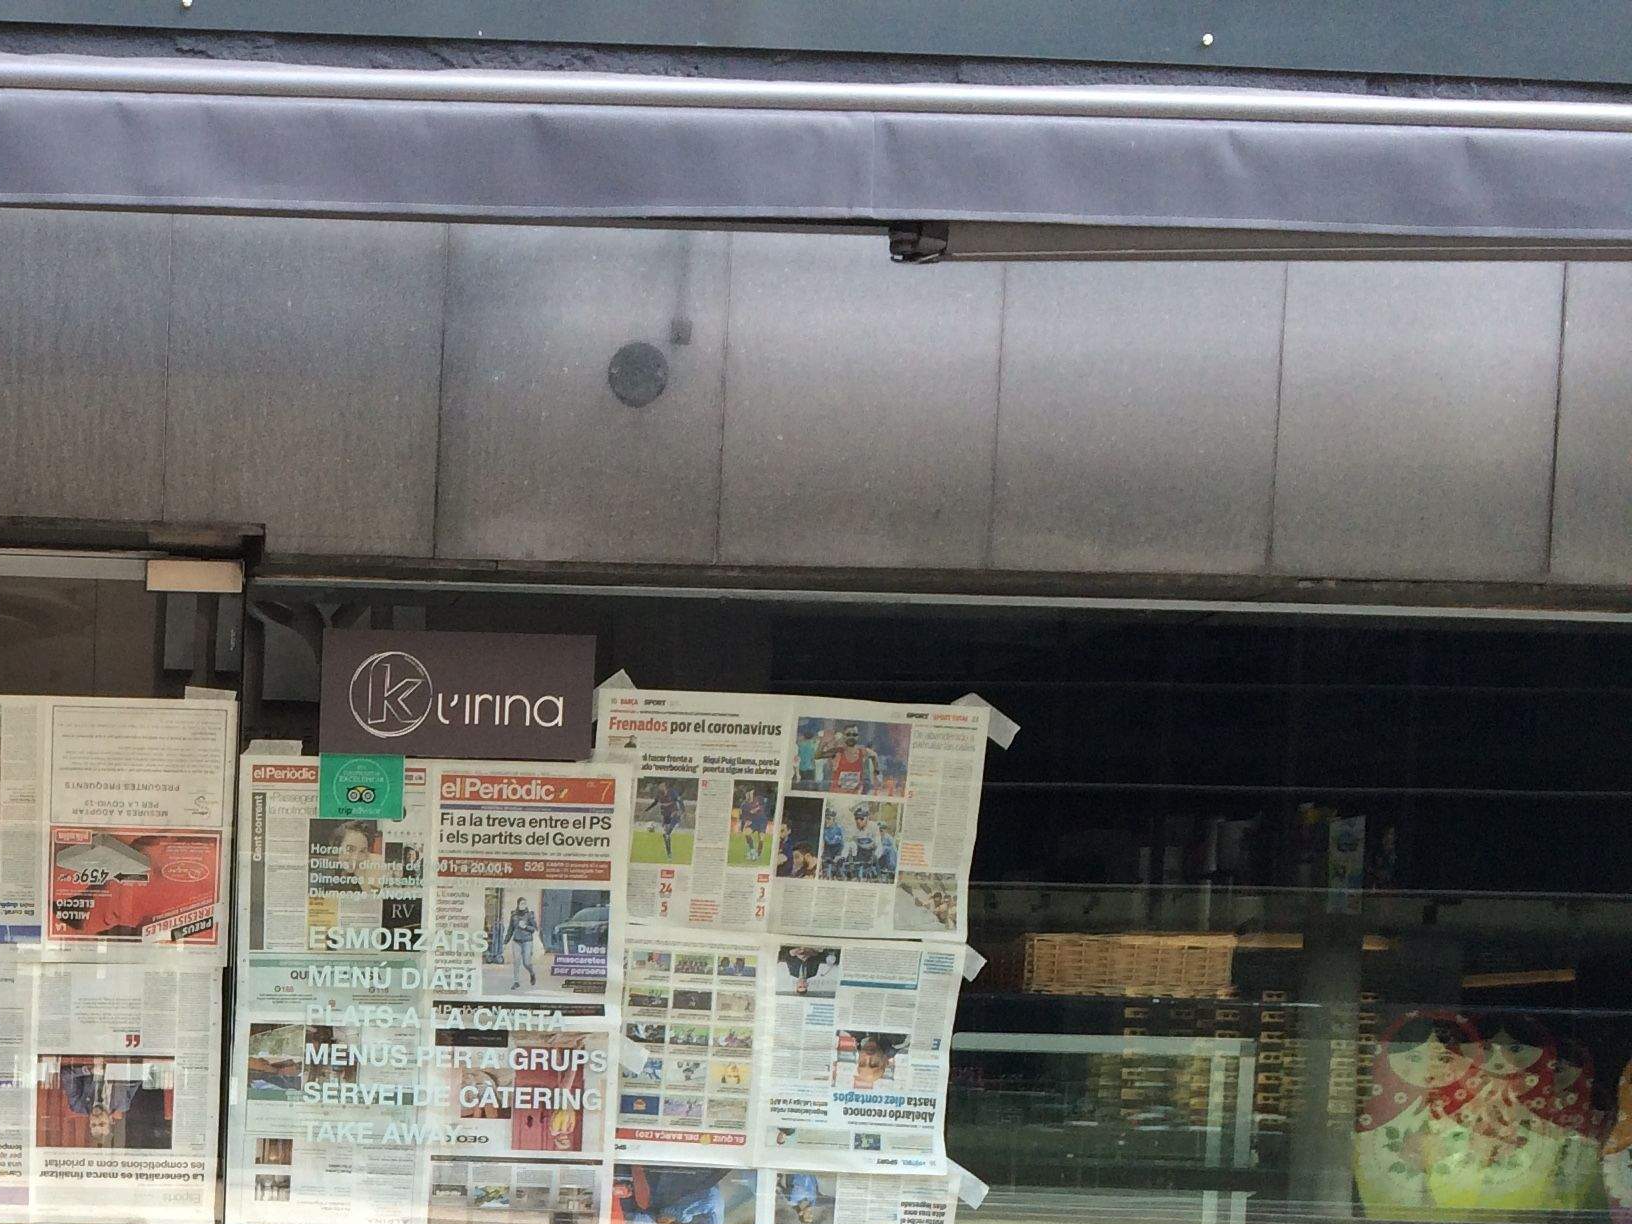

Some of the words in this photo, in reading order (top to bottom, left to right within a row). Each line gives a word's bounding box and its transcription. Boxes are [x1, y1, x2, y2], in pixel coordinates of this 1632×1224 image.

[609, 716, 667, 733] Frenados
[670, 721, 691, 734] por
[694, 719, 705, 733] el
[708, 720, 782, 736] coronavirus
[254, 767, 264, 778] el
[267, 767, 316, 779] Periòdic
[442, 778, 459, 797] el
[465, 778, 555, 801] Periòdic
[440, 812, 454, 826] Fi
[457, 816, 466, 827] a
[470, 813, 482, 827] la
[486, 814, 525, 828] treva
[529, 816, 569, 829] entre
[573, 816, 586, 829] el
[590, 816, 612, 830] PS
[439, 830, 443, 843] i
[447, 830, 468, 843] els
[472, 831, 522, 847] partits
[526, 832, 549, 846] del
[553, 833, 610, 847] Govern
[55, 898, 95, 909] ELECCIÓ
[55, 910, 90, 920] MILLOR
[391, 904, 415, 919] RV
[55, 923, 67, 931] LA
[144, 905, 214, 936] IRRESISTIBLES
[181, 917, 212, 936] PREUS
[309, 927, 489, 952] ESMORZARS
[556, 957, 606, 965] mascaretes
[308, 961, 392, 989] MENÚ
[306, 1004, 394, 1028] PLATS
[400, 1007, 418, 1028] A
[472, 1008, 567, 1031] CARTA
[418, 1046, 472, 1068] PER
[480, 1049, 500, 1070] A
[508, 1048, 608, 1072] GRUPS
[302, 1082, 406, 1106] SERVEI
[459, 1080, 602, 1110] CÀTERING
[832, 1091, 883, 1105] contagios
[883, 1095, 906, 1107] diez
[906, 1097, 937, 1109] hasta
[842, 1106, 888, 1120] reconoce
[888, 1108, 935, 1122] Abelardo
[306, 1122, 373, 1144] TAKE
[382, 1122, 462, 1146] AWAY
[458, 1134, 490, 1146] GEO
[39, 1169, 84, 1181] finalitzar
[86, 1170, 119, 1180] marca
[120, 1171, 133, 1180] es
[135, 1171, 190, 1183] Generalitat
[191, 1171, 205, 1182] La
[162, 1192, 202, 1206] Esports
